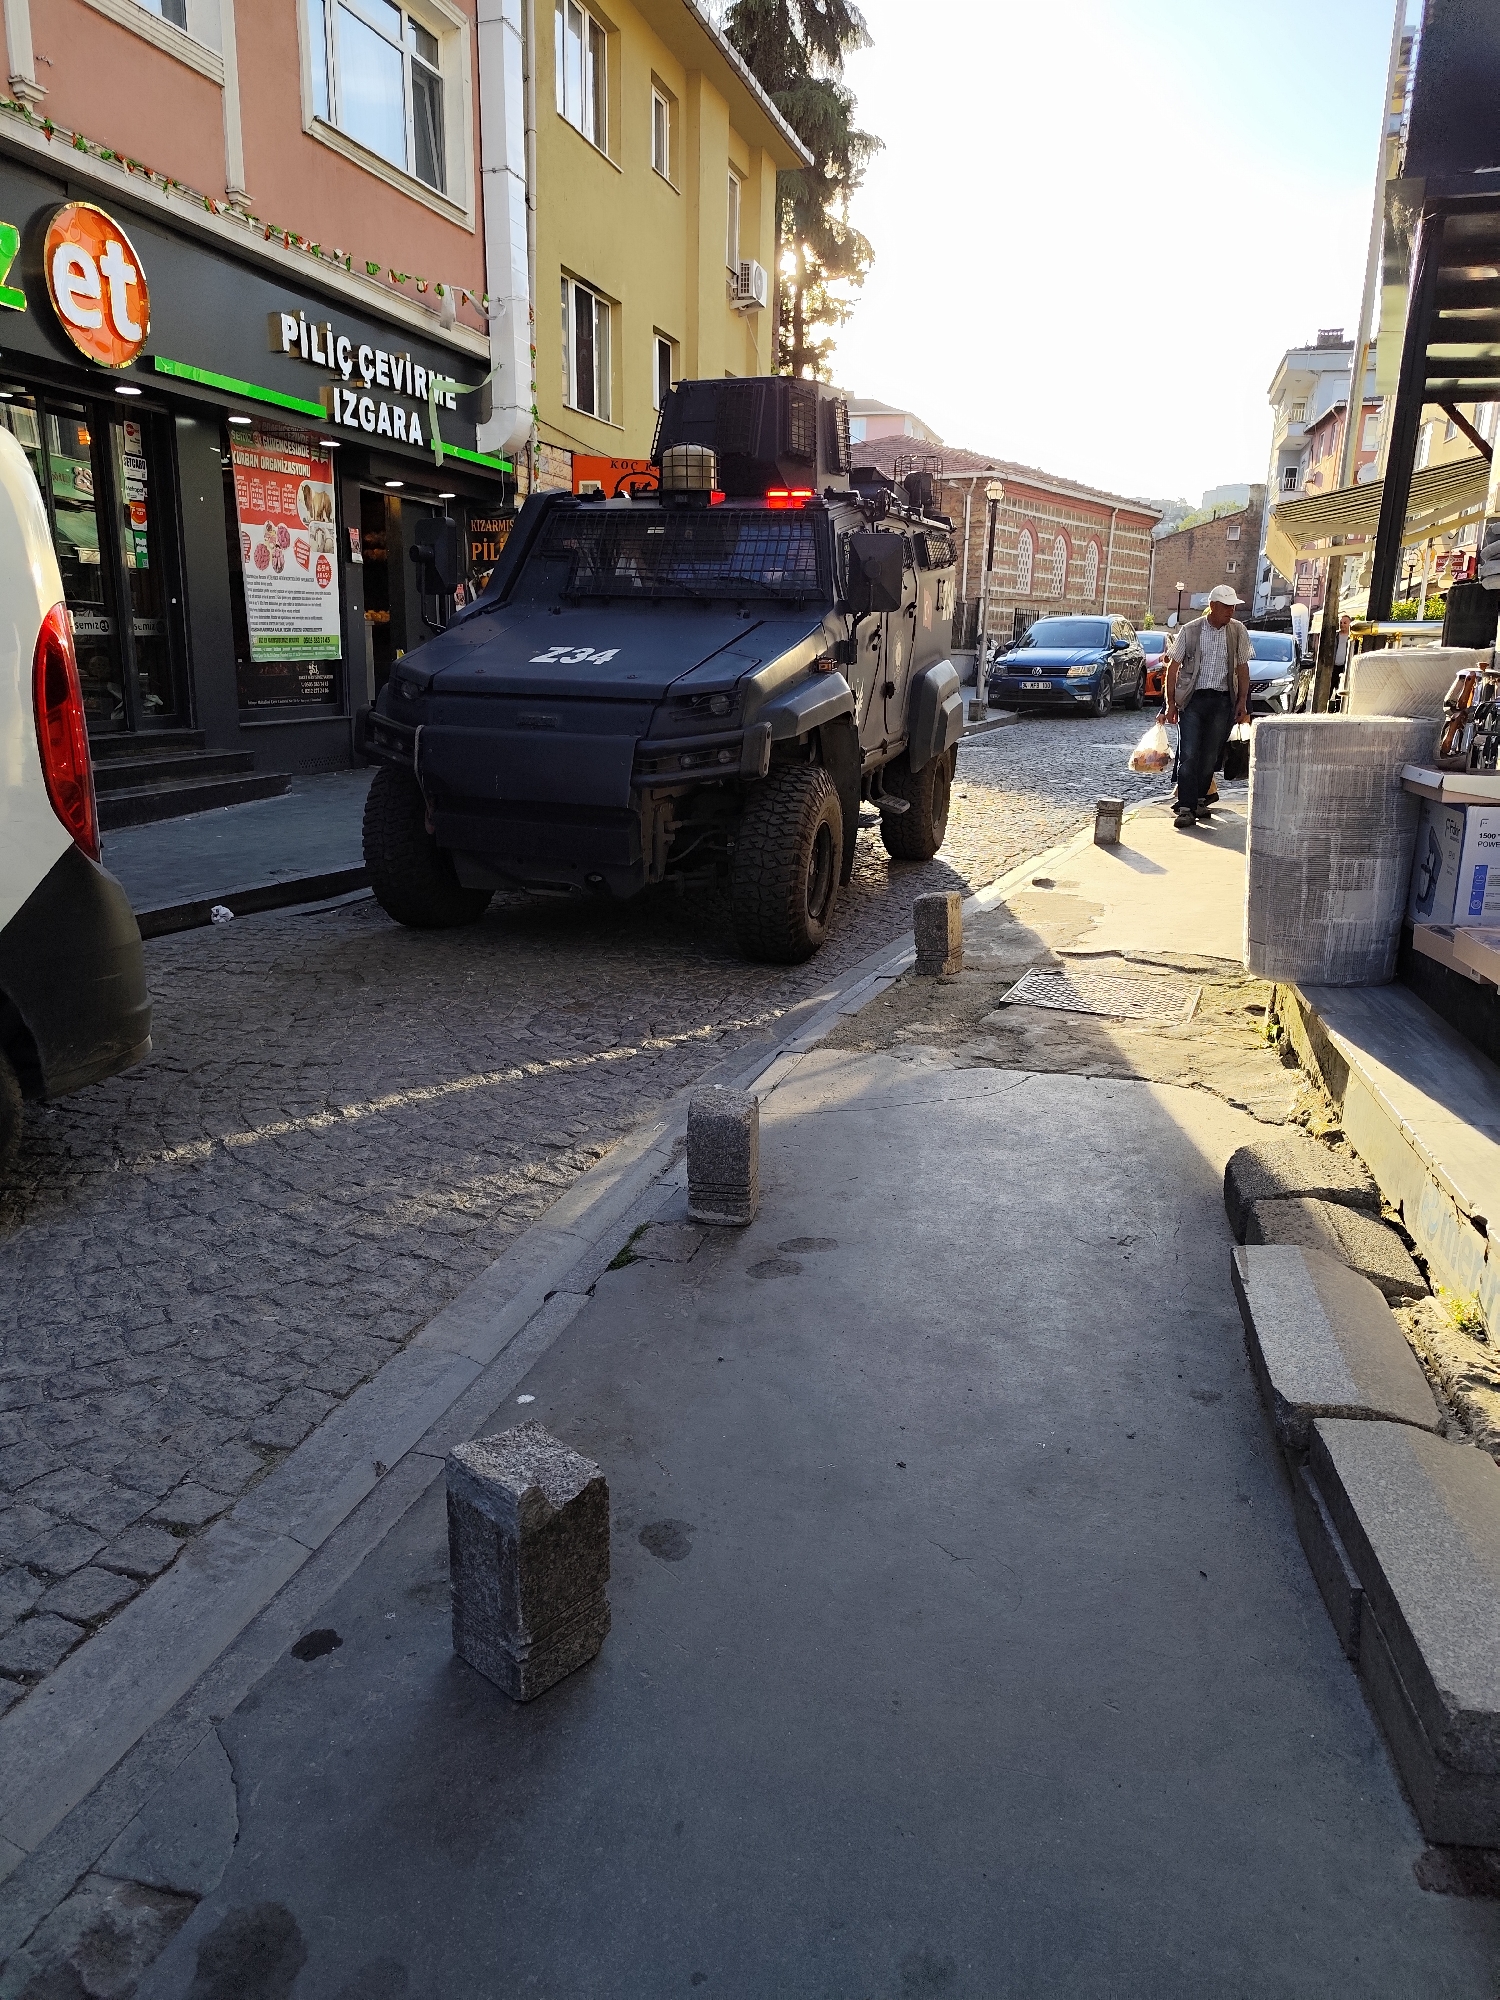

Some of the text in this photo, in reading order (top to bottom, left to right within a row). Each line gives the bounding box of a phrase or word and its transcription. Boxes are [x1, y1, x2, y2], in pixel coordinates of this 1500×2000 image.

[53, 238, 143, 342] et
[281, 310, 457, 411] PİLİÇ ÇEVİRME
[333, 387, 424, 446] IZGARA
[610, 460, 638, 473] KOÇ
[75, 621, 99, 630] semiz
[528, 646, 622, 665] Z34
